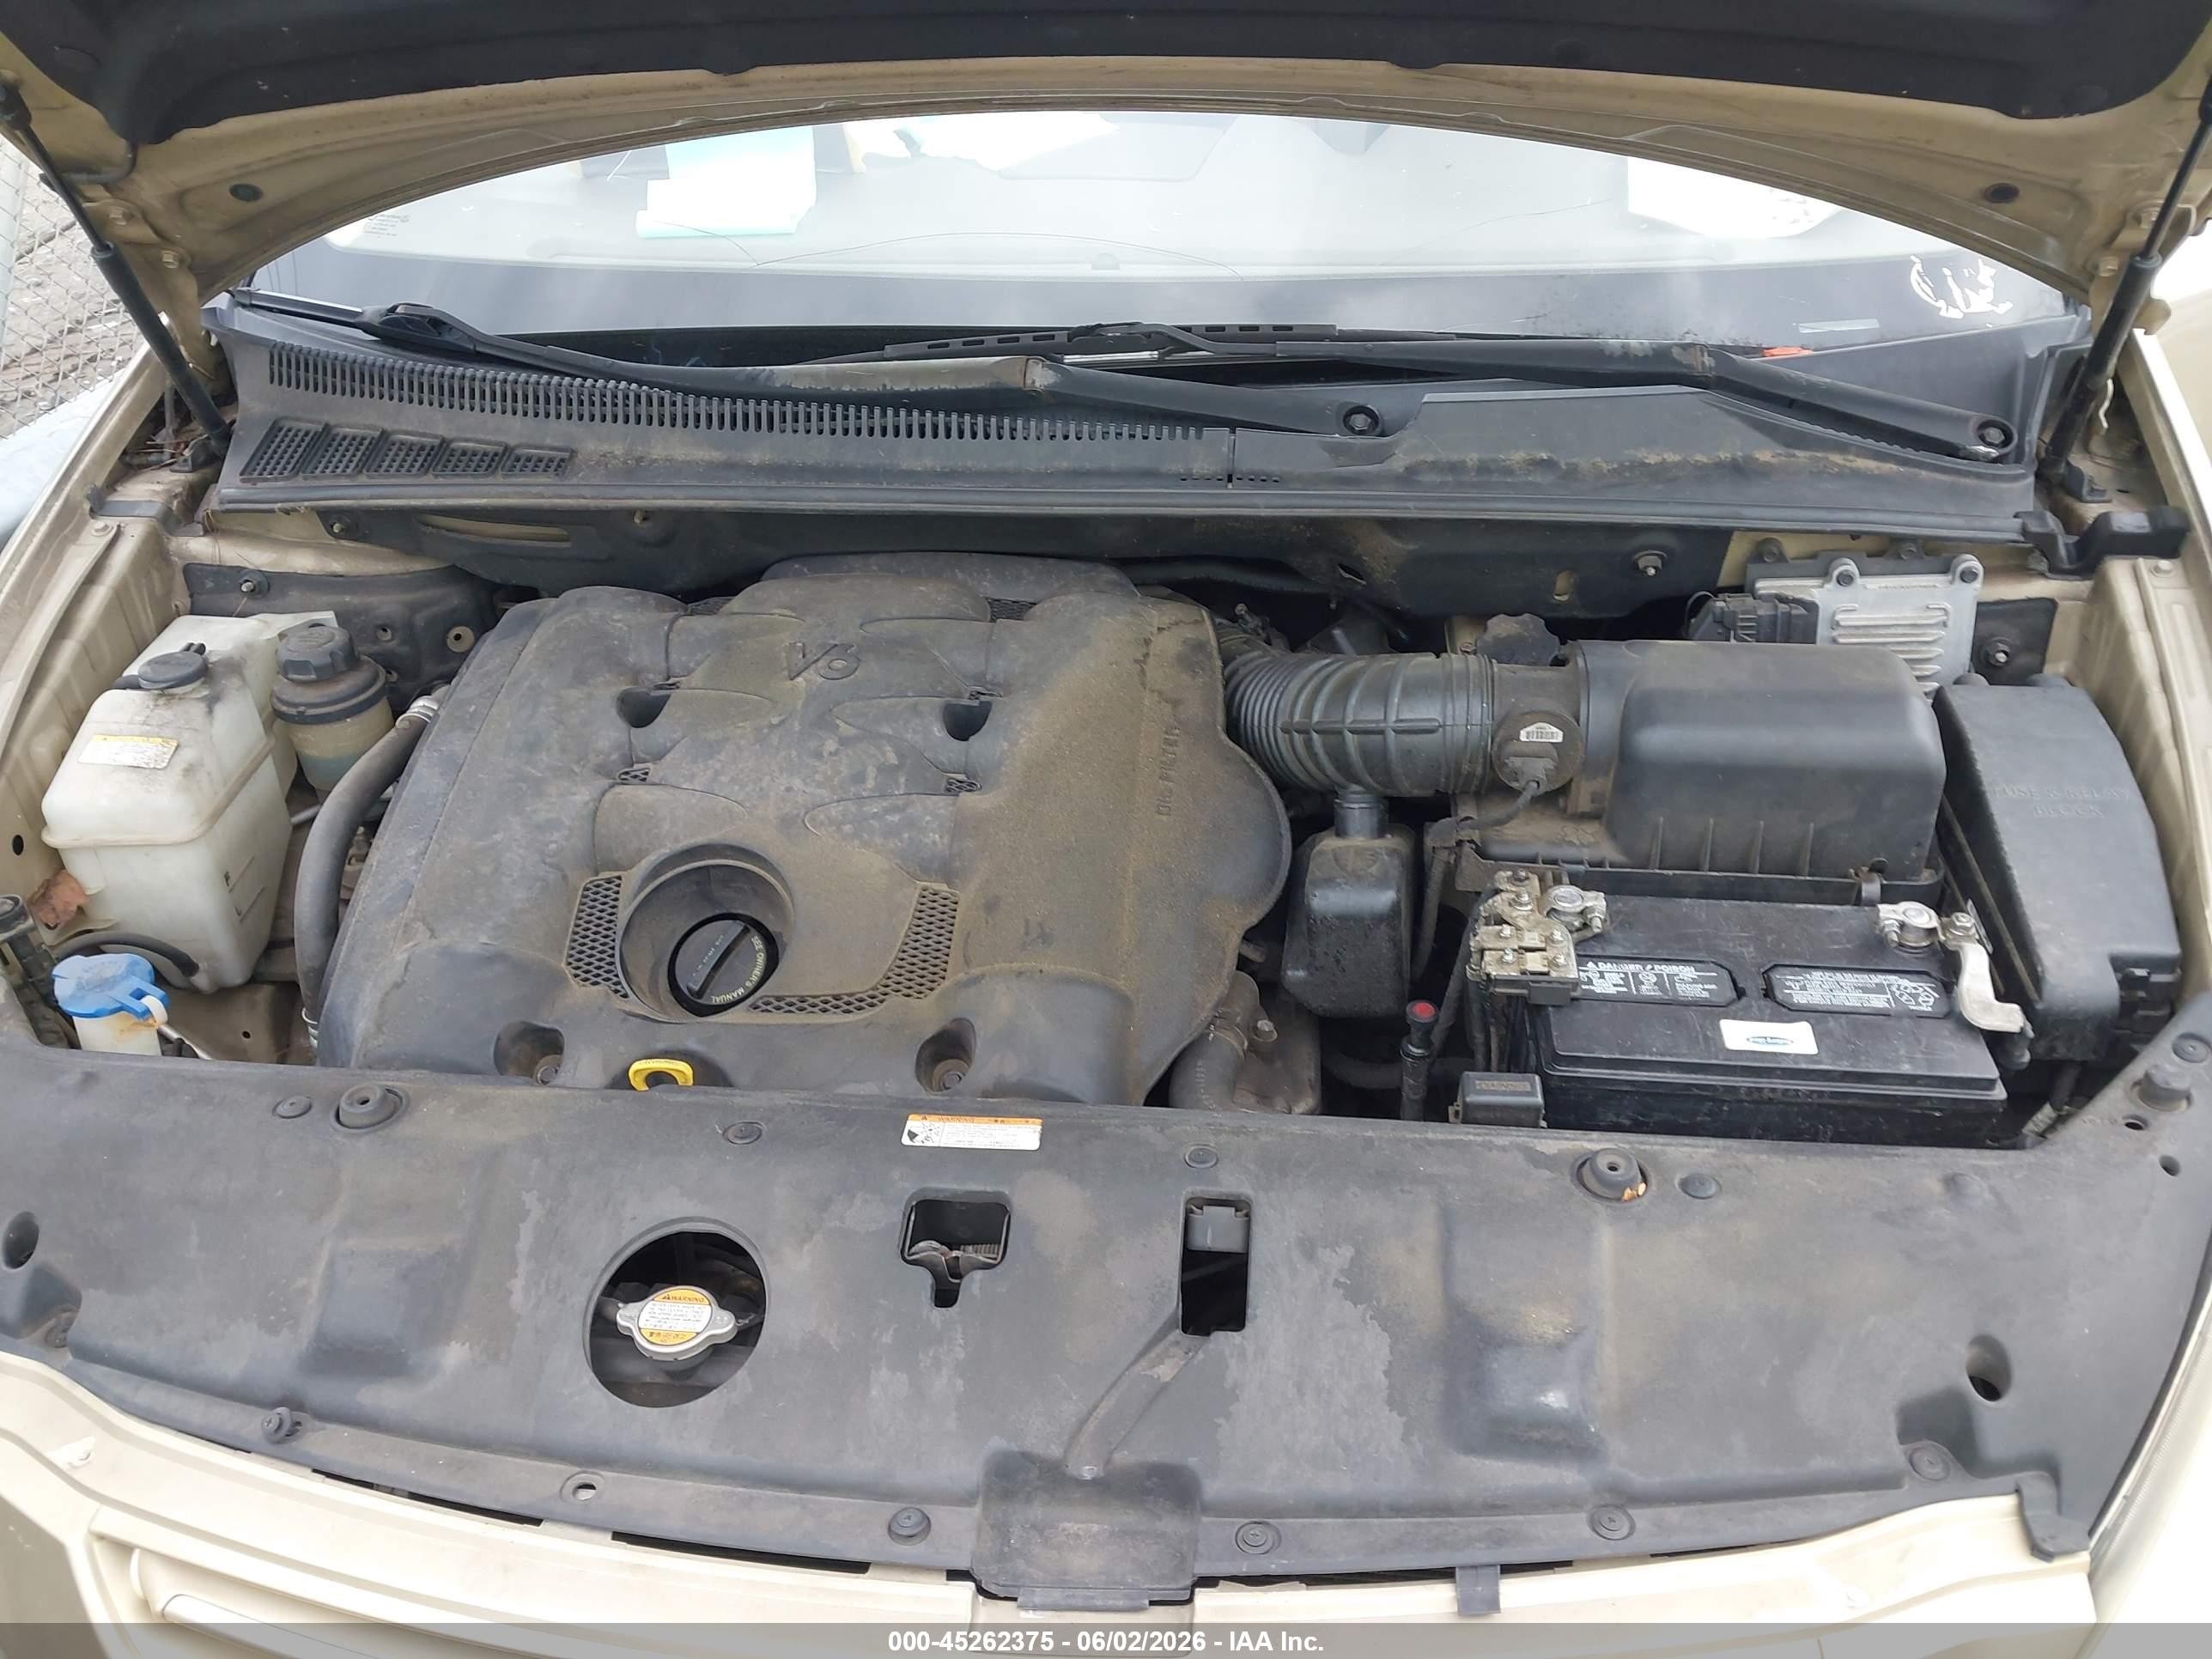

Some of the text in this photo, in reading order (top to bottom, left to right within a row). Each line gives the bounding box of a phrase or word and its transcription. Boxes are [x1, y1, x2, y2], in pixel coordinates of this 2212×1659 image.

[785, 641, 860, 681] V6
[2033, 803, 2105, 817] BLOCK
[710, 987, 745, 1004] MANUAL
